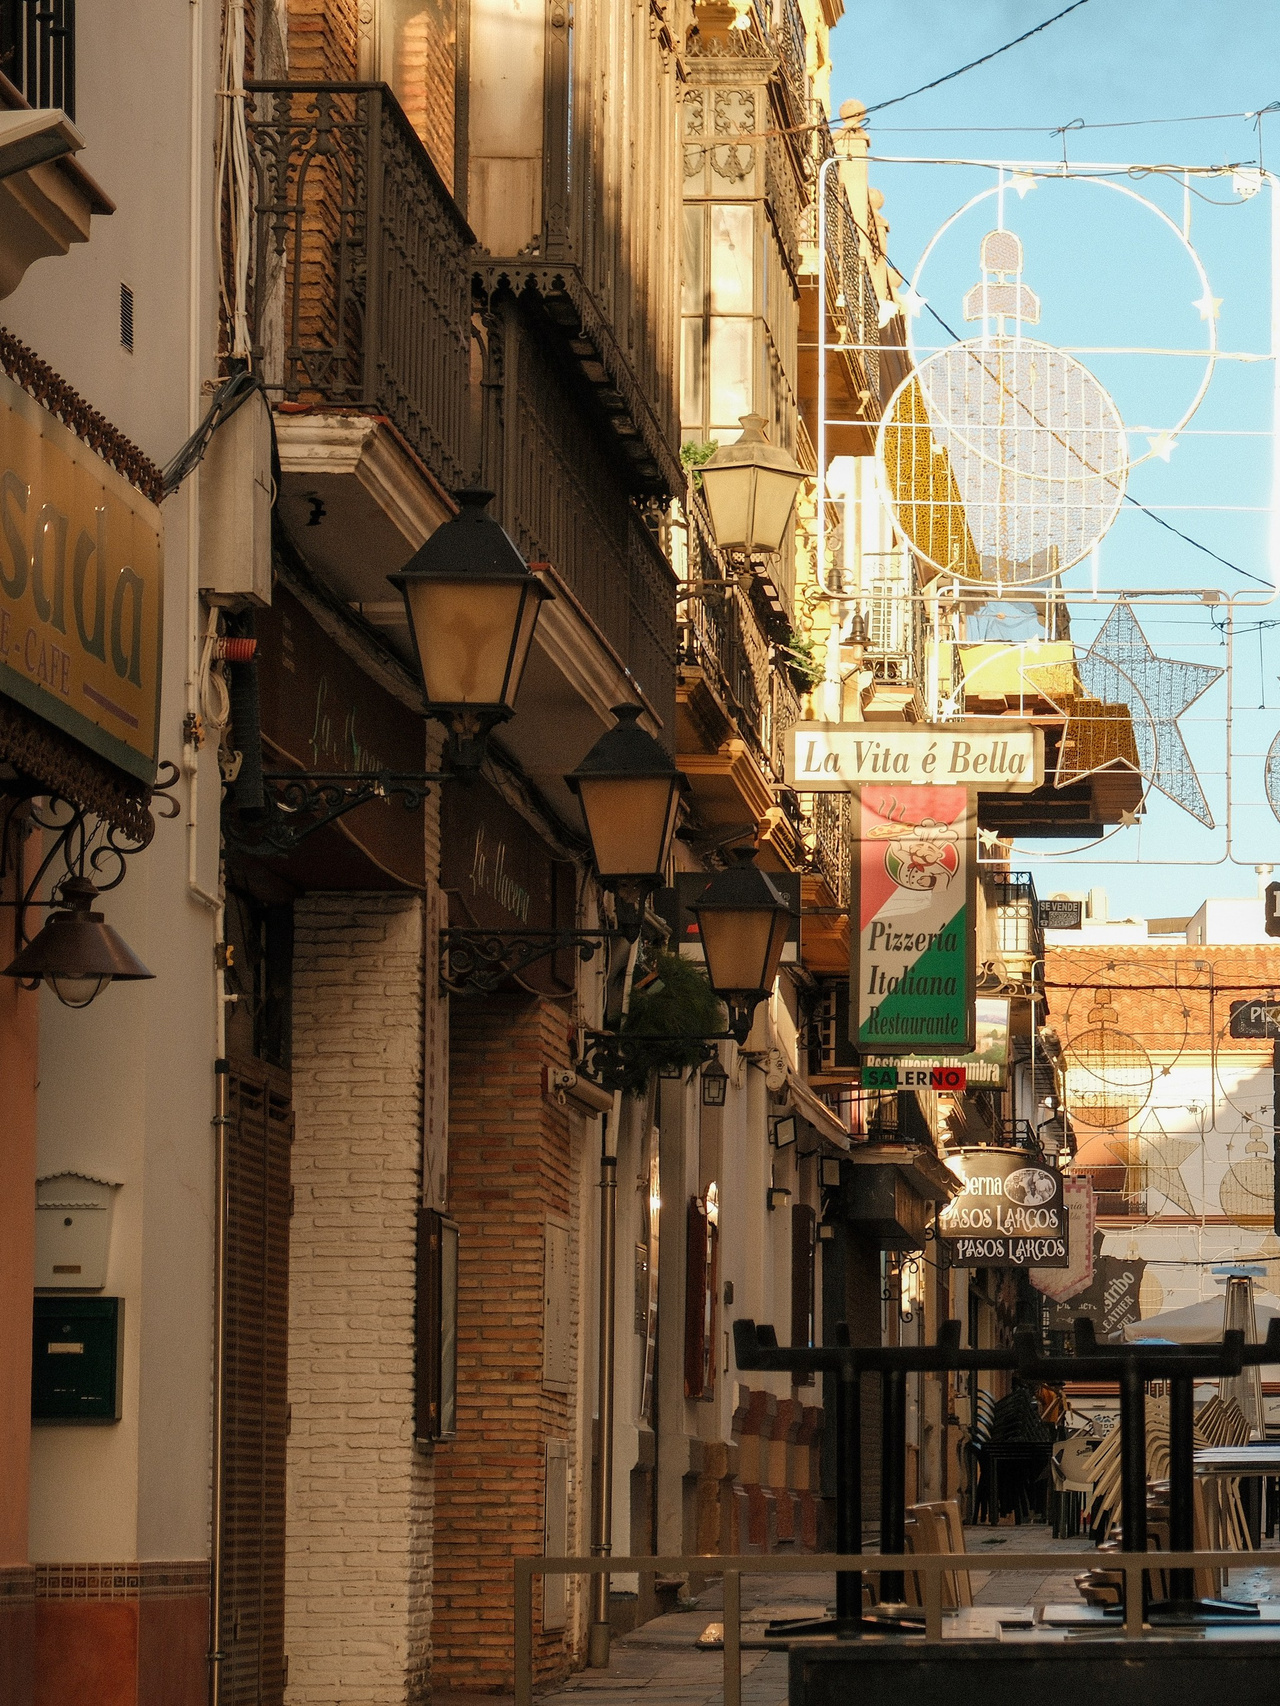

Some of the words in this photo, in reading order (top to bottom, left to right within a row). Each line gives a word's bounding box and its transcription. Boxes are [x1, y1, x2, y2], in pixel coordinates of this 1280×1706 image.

[0, 469, 144, 690] sada
[801, 740, 841, 774] La
[854, 740, 910, 774] Vita
[920, 742, 938, 774] é
[947, 741, 1027, 775] Bella
[1041, 902, 1050, 911] SE
[1051, 903, 1078, 911] VENDE
[867, 920, 958, 953] Pizzería
[867, 965, 957, 997] Italiana
[867, 1006, 959, 1038] Restaurante
[868, 1071, 960, 1086] SALERNO
[961, 1170, 1003, 1197] berna
[941, 1208, 993, 1230] PASOS
[996, 1205, 1059, 1235] LARGOS
[956, 1239, 1005, 1260] PASOS
[1008, 1239, 1065, 1264] LARGOS
[1104, 1271, 1135, 1313] stribo
